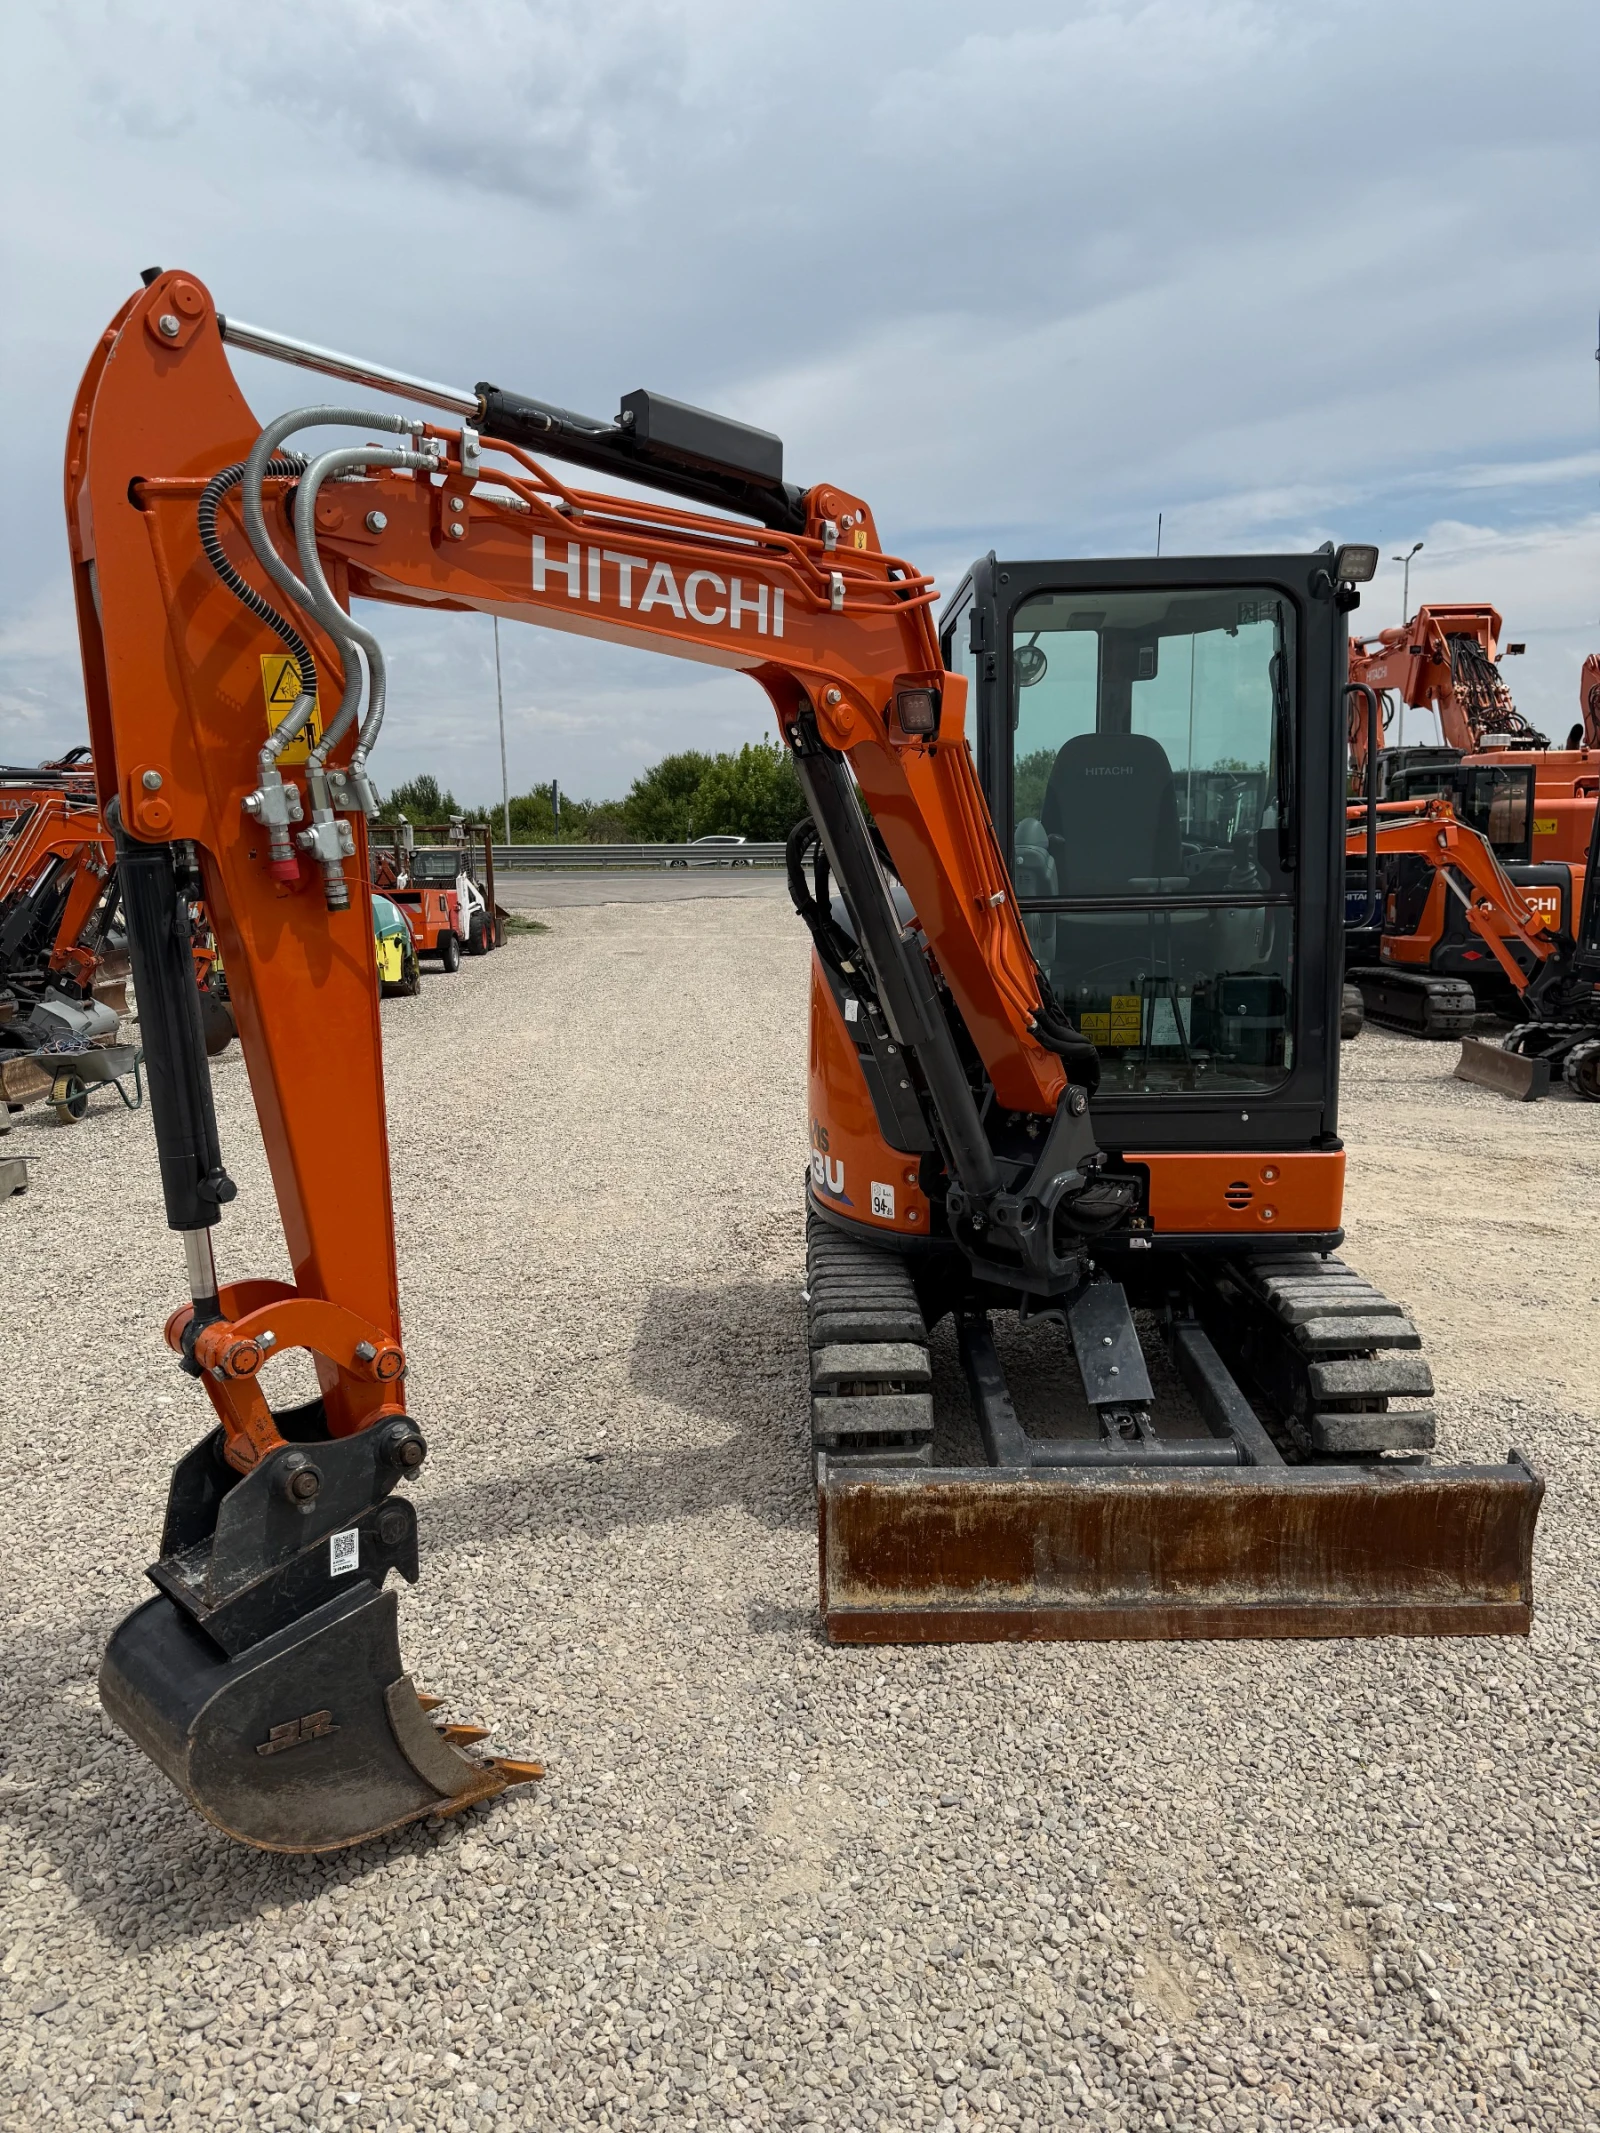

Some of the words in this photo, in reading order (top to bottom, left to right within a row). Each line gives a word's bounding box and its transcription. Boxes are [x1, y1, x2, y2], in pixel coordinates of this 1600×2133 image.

[531, 534, 785, 638] HITACHI
[1085, 766, 1133, 776] HITACHI
[873, 1196, 888, 1214] 94
